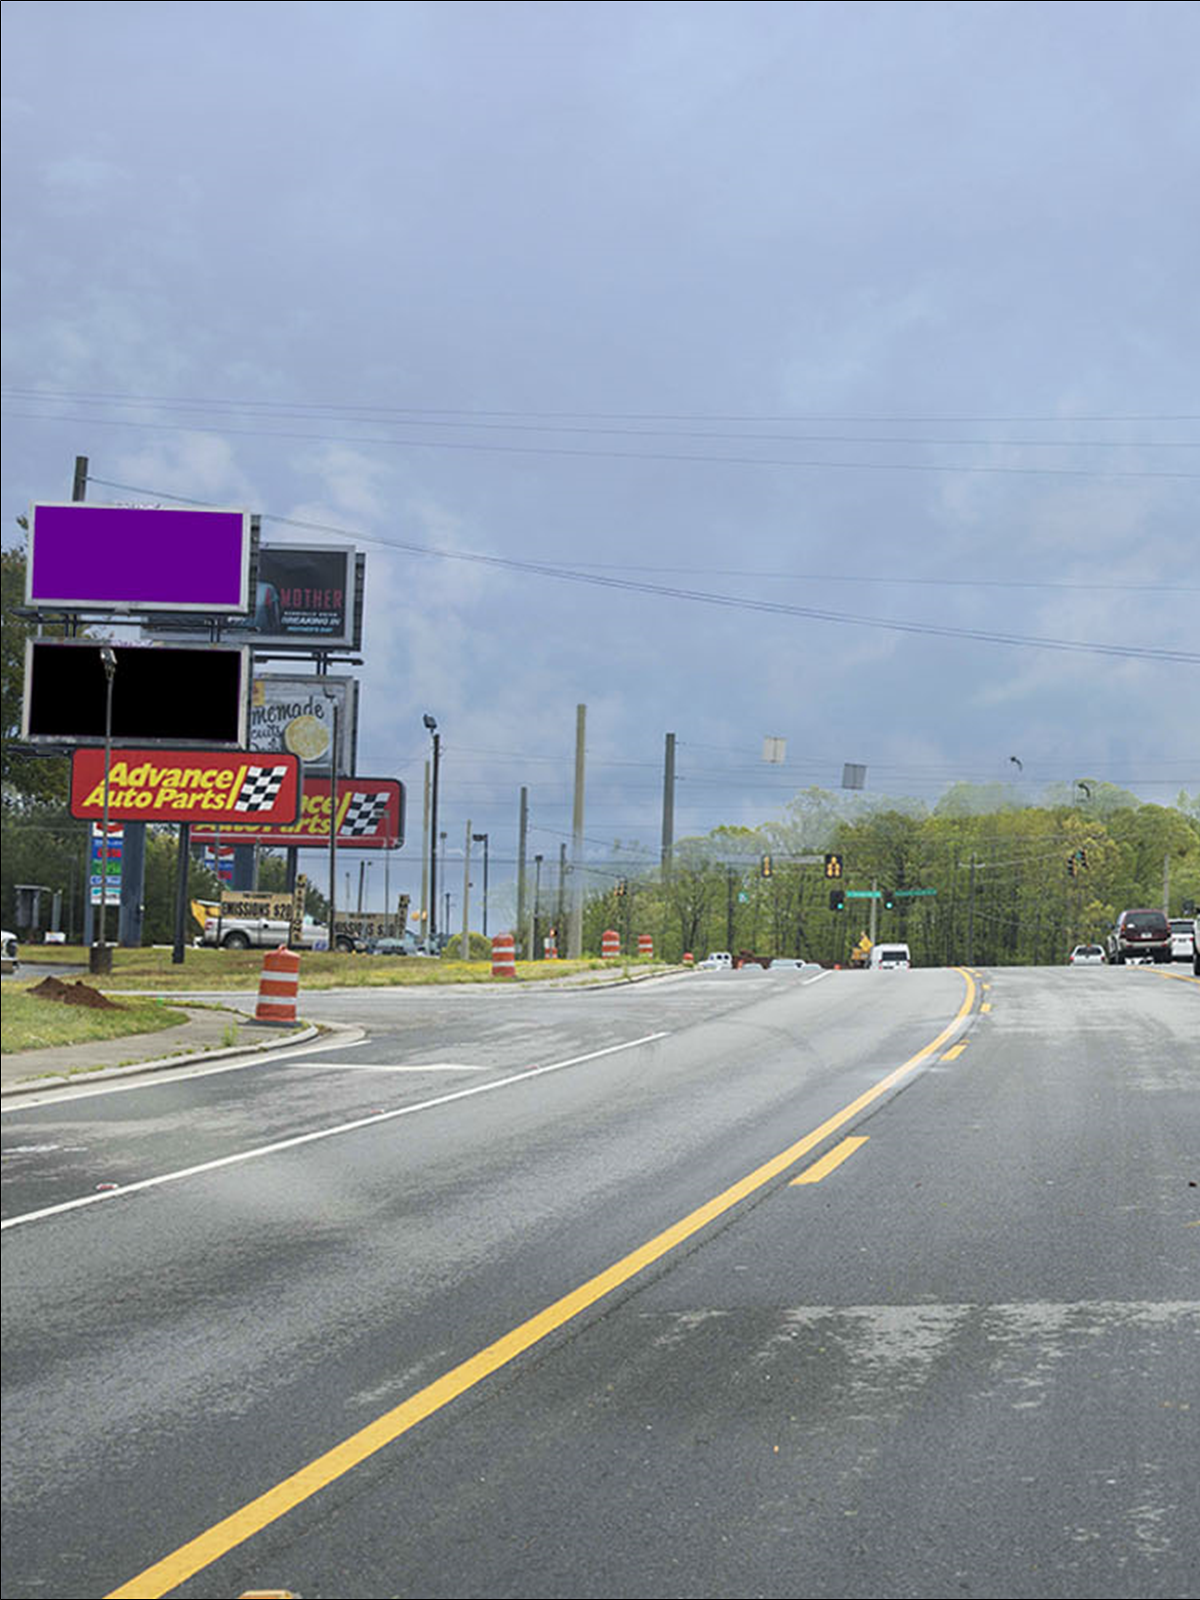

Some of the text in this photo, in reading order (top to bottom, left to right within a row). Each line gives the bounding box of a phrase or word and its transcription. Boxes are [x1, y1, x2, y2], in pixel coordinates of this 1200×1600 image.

[280, 588, 344, 609] MOTHER
[250, 695, 325, 725] memade
[101, 762, 235, 789] Advance
[82, 785, 228, 811] Auto Parts
